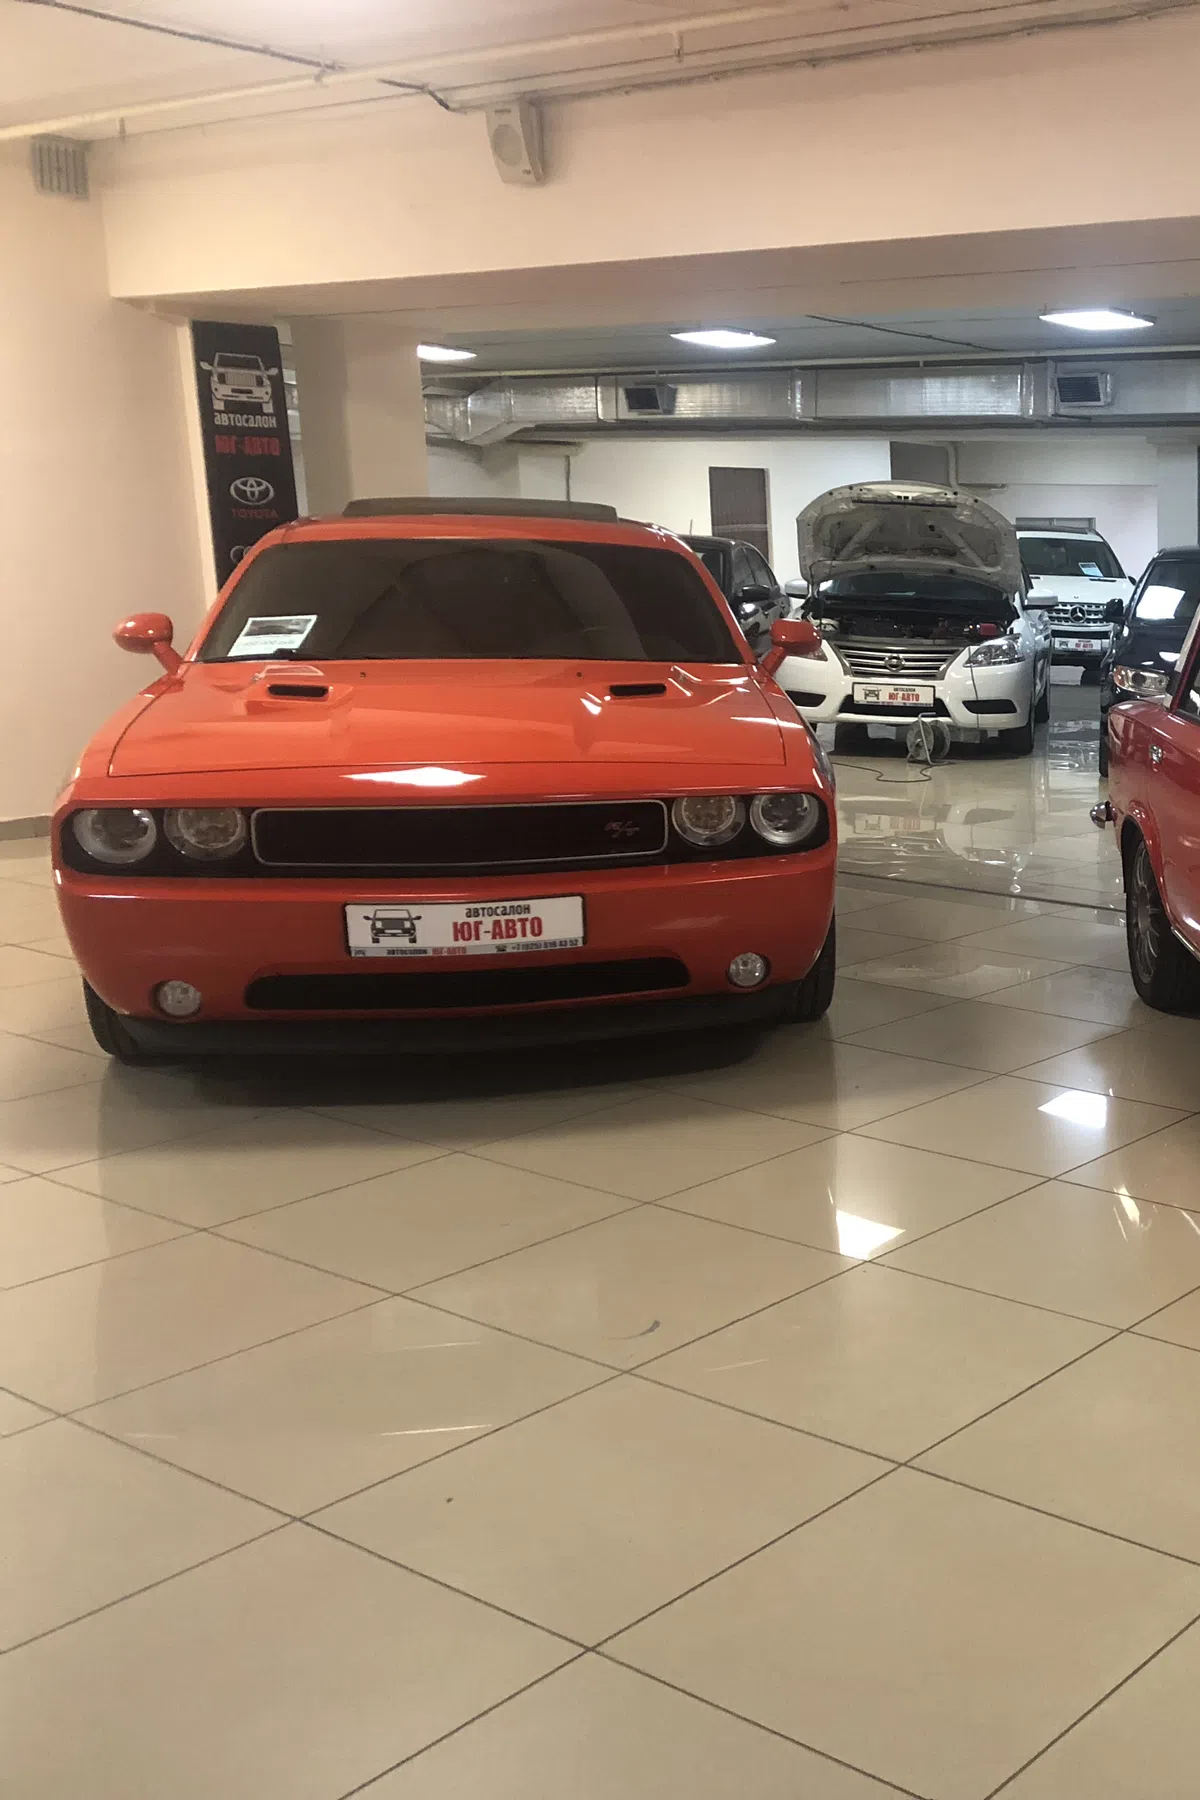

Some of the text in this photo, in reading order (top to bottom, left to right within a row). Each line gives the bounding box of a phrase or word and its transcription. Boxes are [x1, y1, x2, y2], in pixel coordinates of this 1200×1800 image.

[214, 412, 277, 428] автосалон
[231, 508, 279, 520] TOYOTA
[465, 903, 531, 919] автосалон
[452, 916, 543, 942] ЮГ-АВТО
